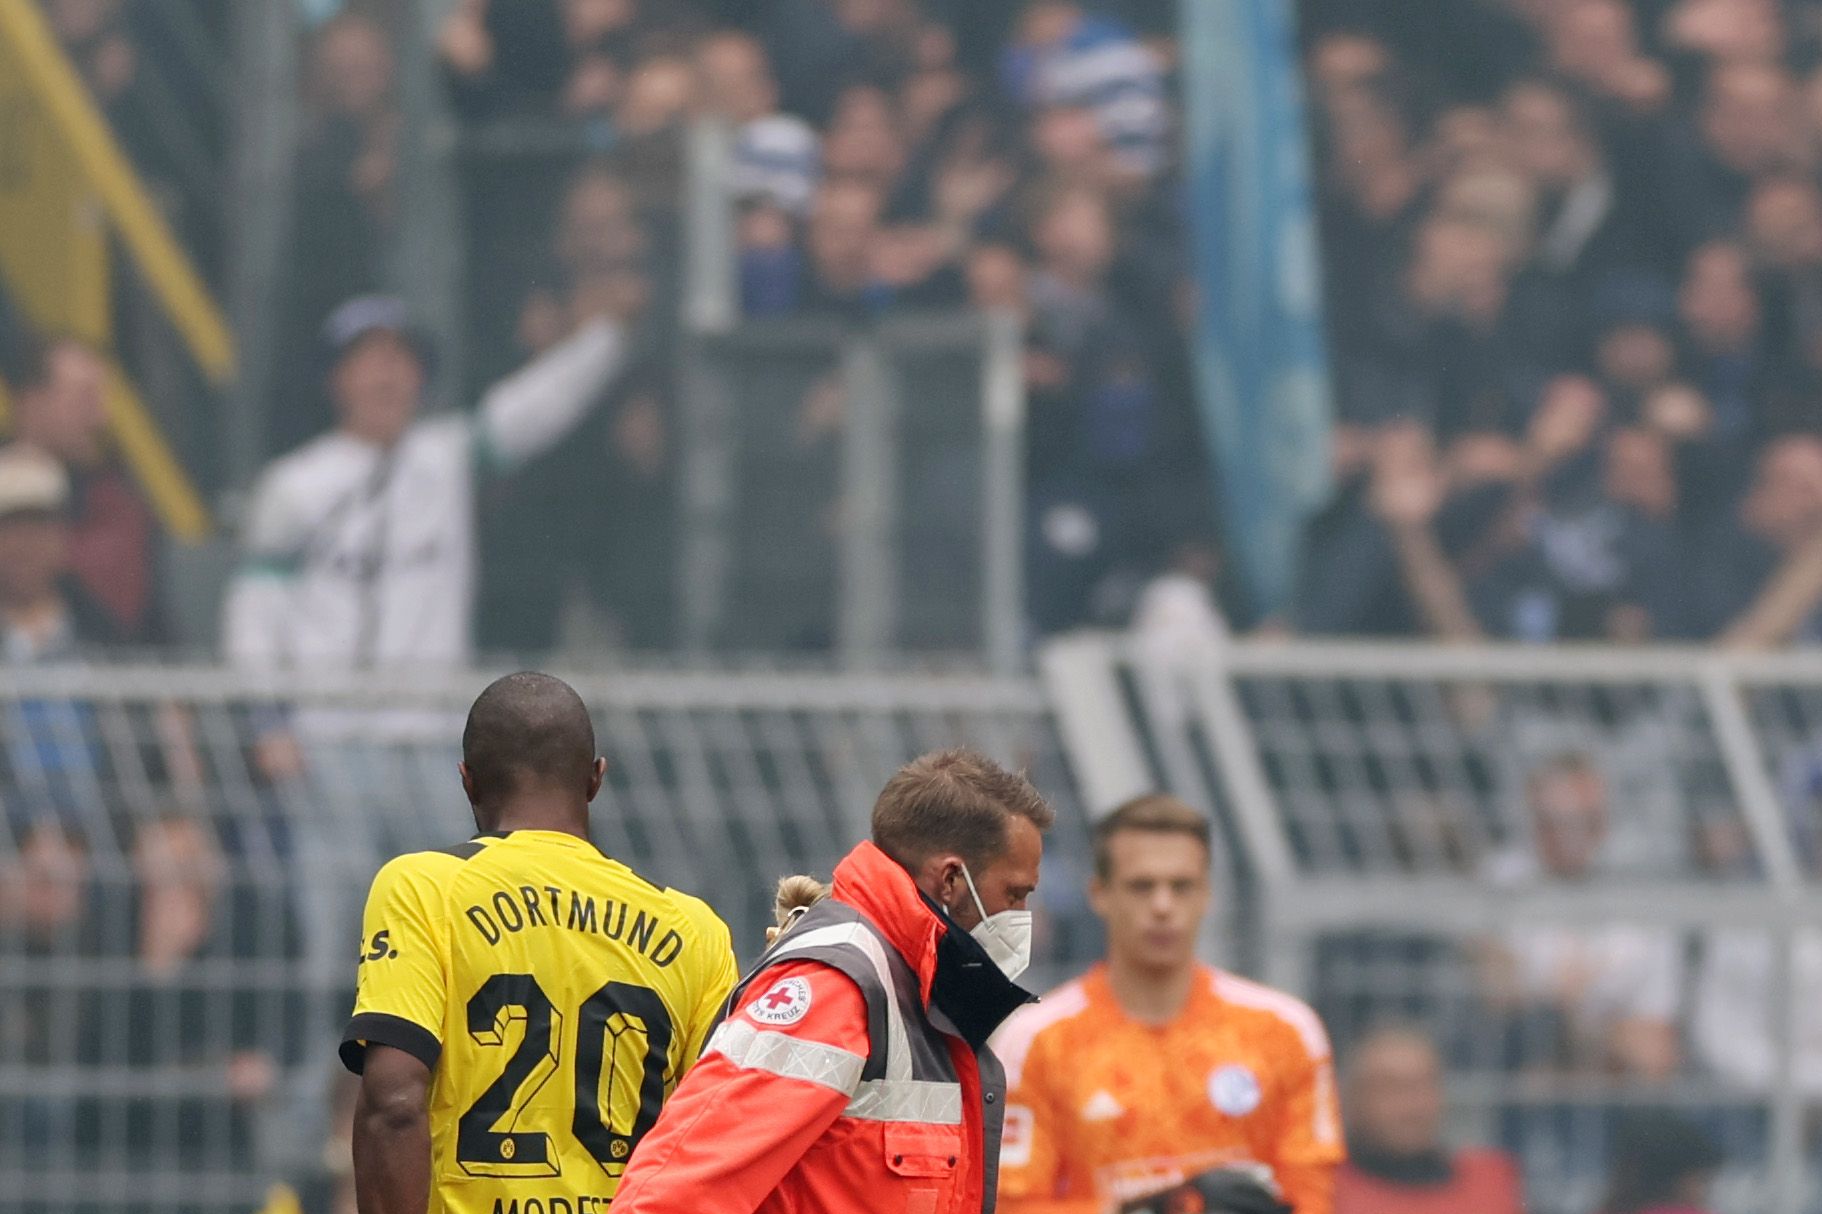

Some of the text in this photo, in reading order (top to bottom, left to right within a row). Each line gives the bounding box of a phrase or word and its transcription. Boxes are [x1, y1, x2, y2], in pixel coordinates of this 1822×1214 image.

[465, 886, 683, 969] DORTMUND
[766, 1004, 801, 1021] KREUZ
[456, 973, 678, 1178] 20
